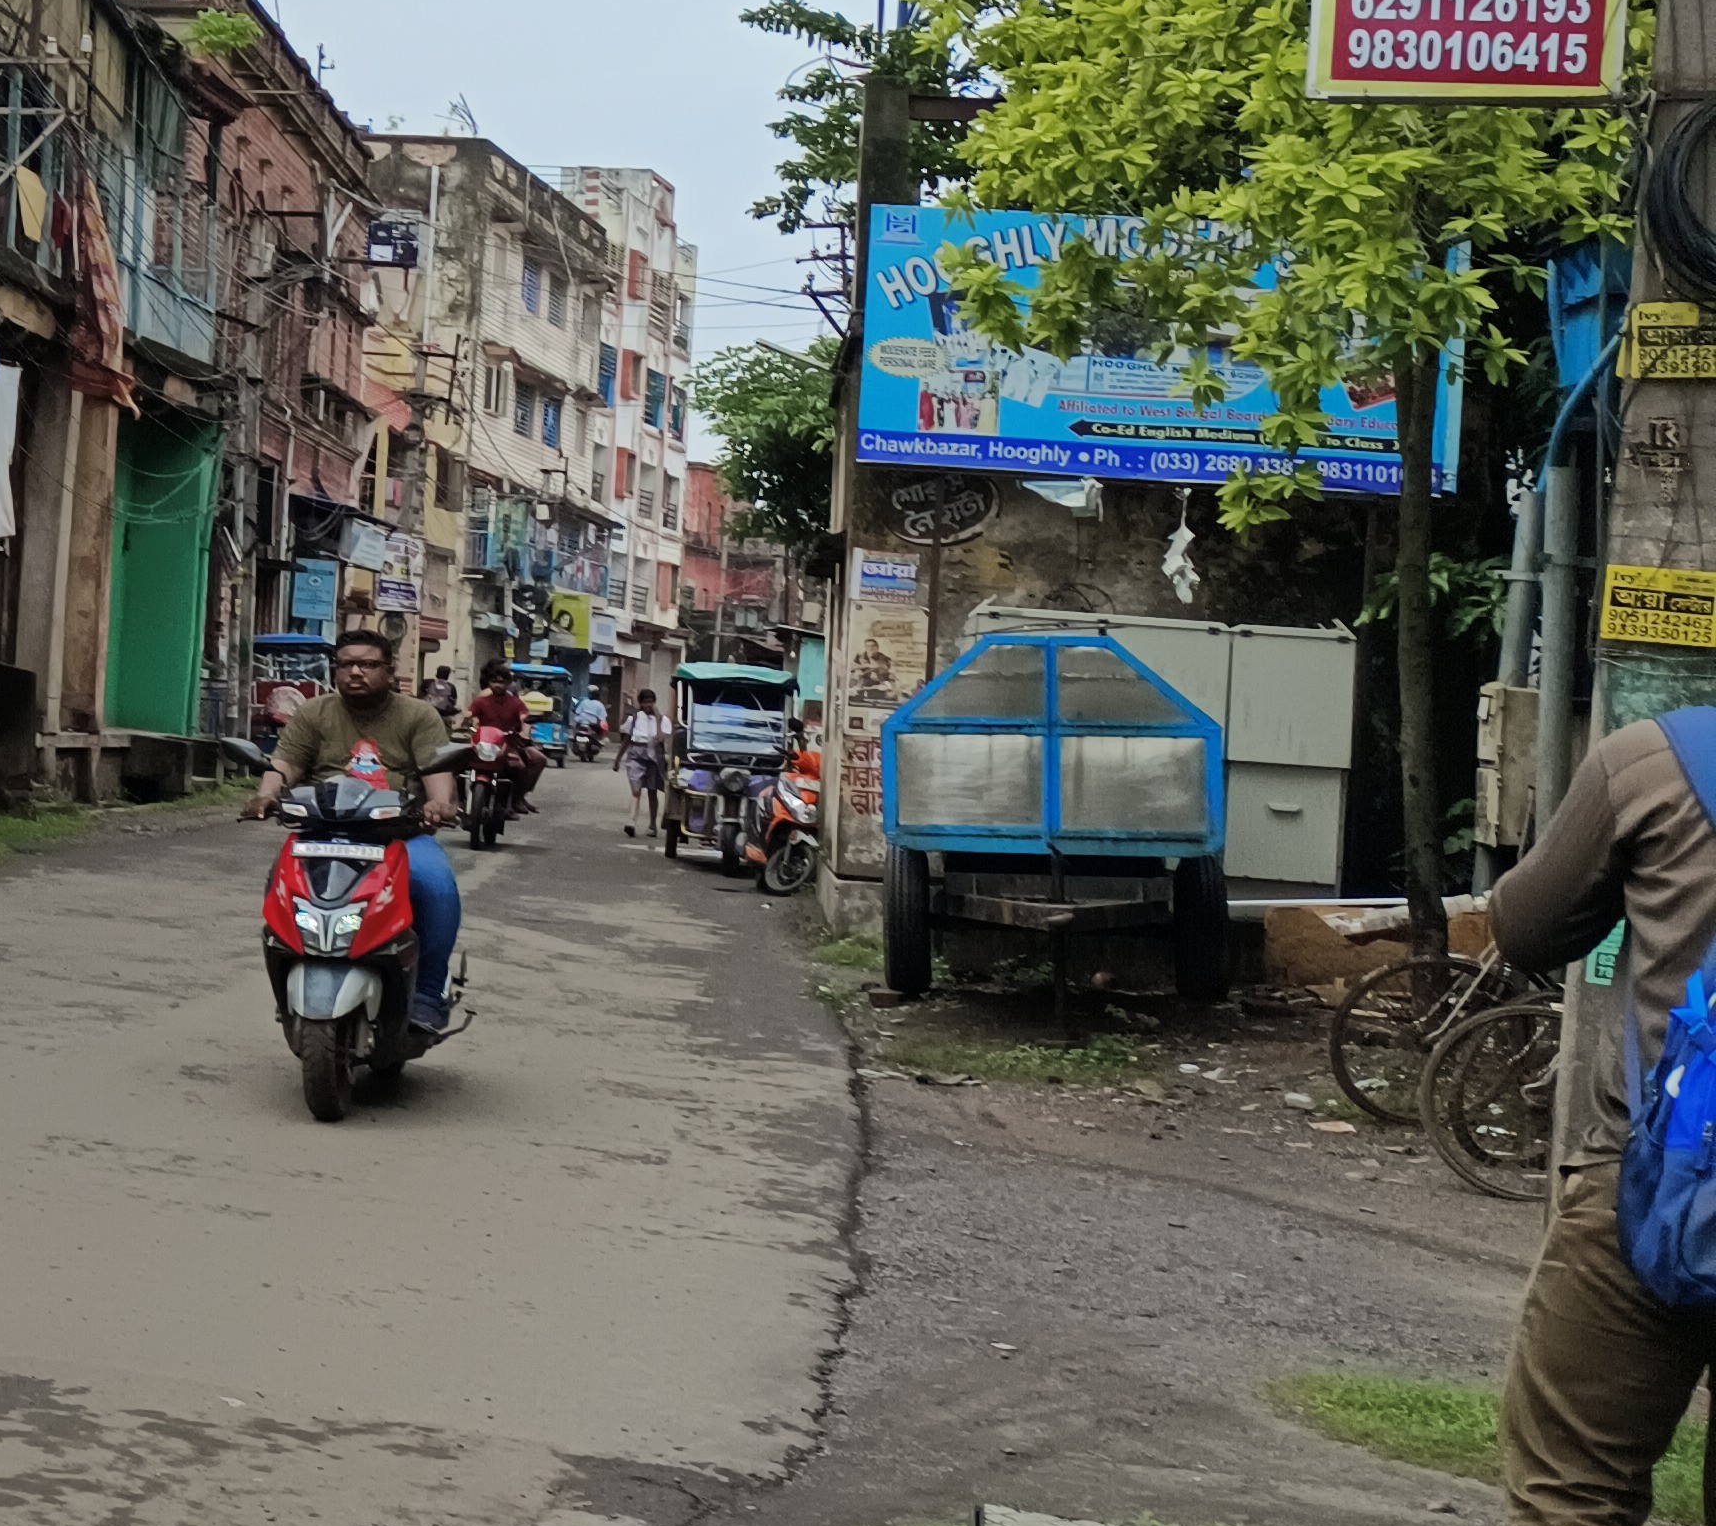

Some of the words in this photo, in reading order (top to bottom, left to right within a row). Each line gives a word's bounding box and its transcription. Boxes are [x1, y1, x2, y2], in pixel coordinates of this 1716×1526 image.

[1347, 28, 1589, 74] 9830106415
[1057, 399, 1118, 415] Affiliated
[1122, 403, 1135, 416] to
[1140, 405, 1172, 417] West
[860, 433, 983, 460] Chawkbazar,
[989, 440, 1071, 467] Hooghly
[1150, 451, 1200, 474] (033)
[1091, 423, 1135, 437] Co-Ed
[1139, 425, 1192, 440] English
[1195, 429, 1256, 442] Medium
[1345, 437, 1384, 451] Class
